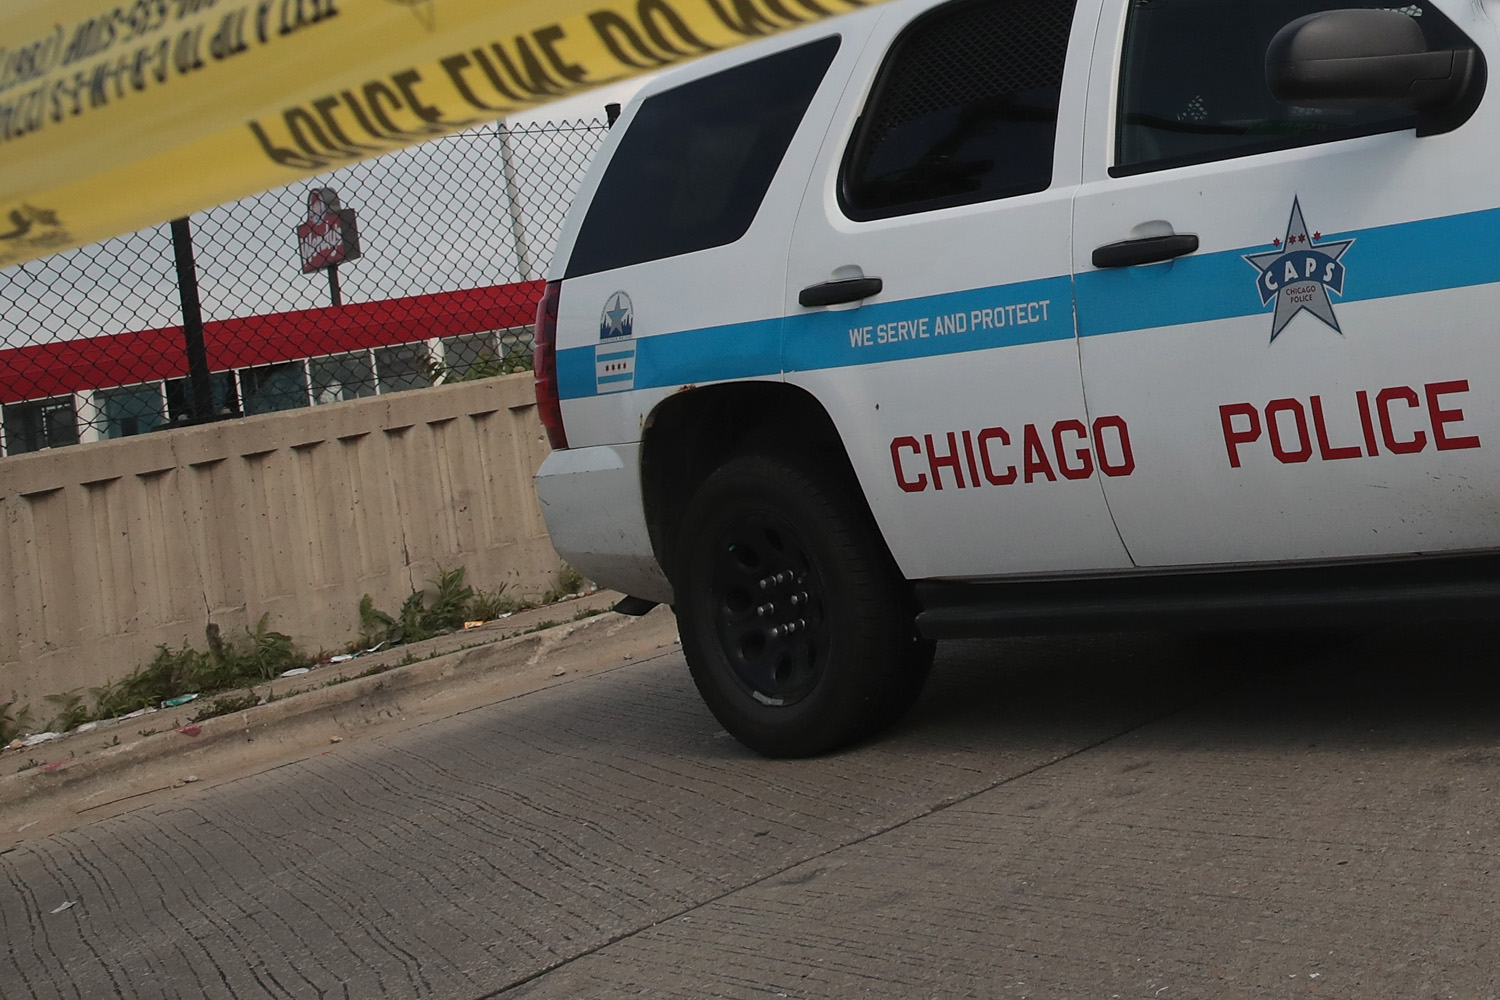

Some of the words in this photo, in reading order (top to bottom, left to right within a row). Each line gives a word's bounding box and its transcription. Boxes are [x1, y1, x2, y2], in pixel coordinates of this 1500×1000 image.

[1264, 257, 1335, 291] CAPS
[1285, 285, 1316, 296] CHICAGO
[1290, 294, 1313, 304] POLICE
[849, 326, 874, 348] WE
[877, 317, 930, 344] SERVE
[934, 312, 967, 336] AND
[971, 300, 1050, 331] PROTECT
[890, 415, 1135, 493] CHICAGO
[1218, 379, 1481, 468] POLICE
